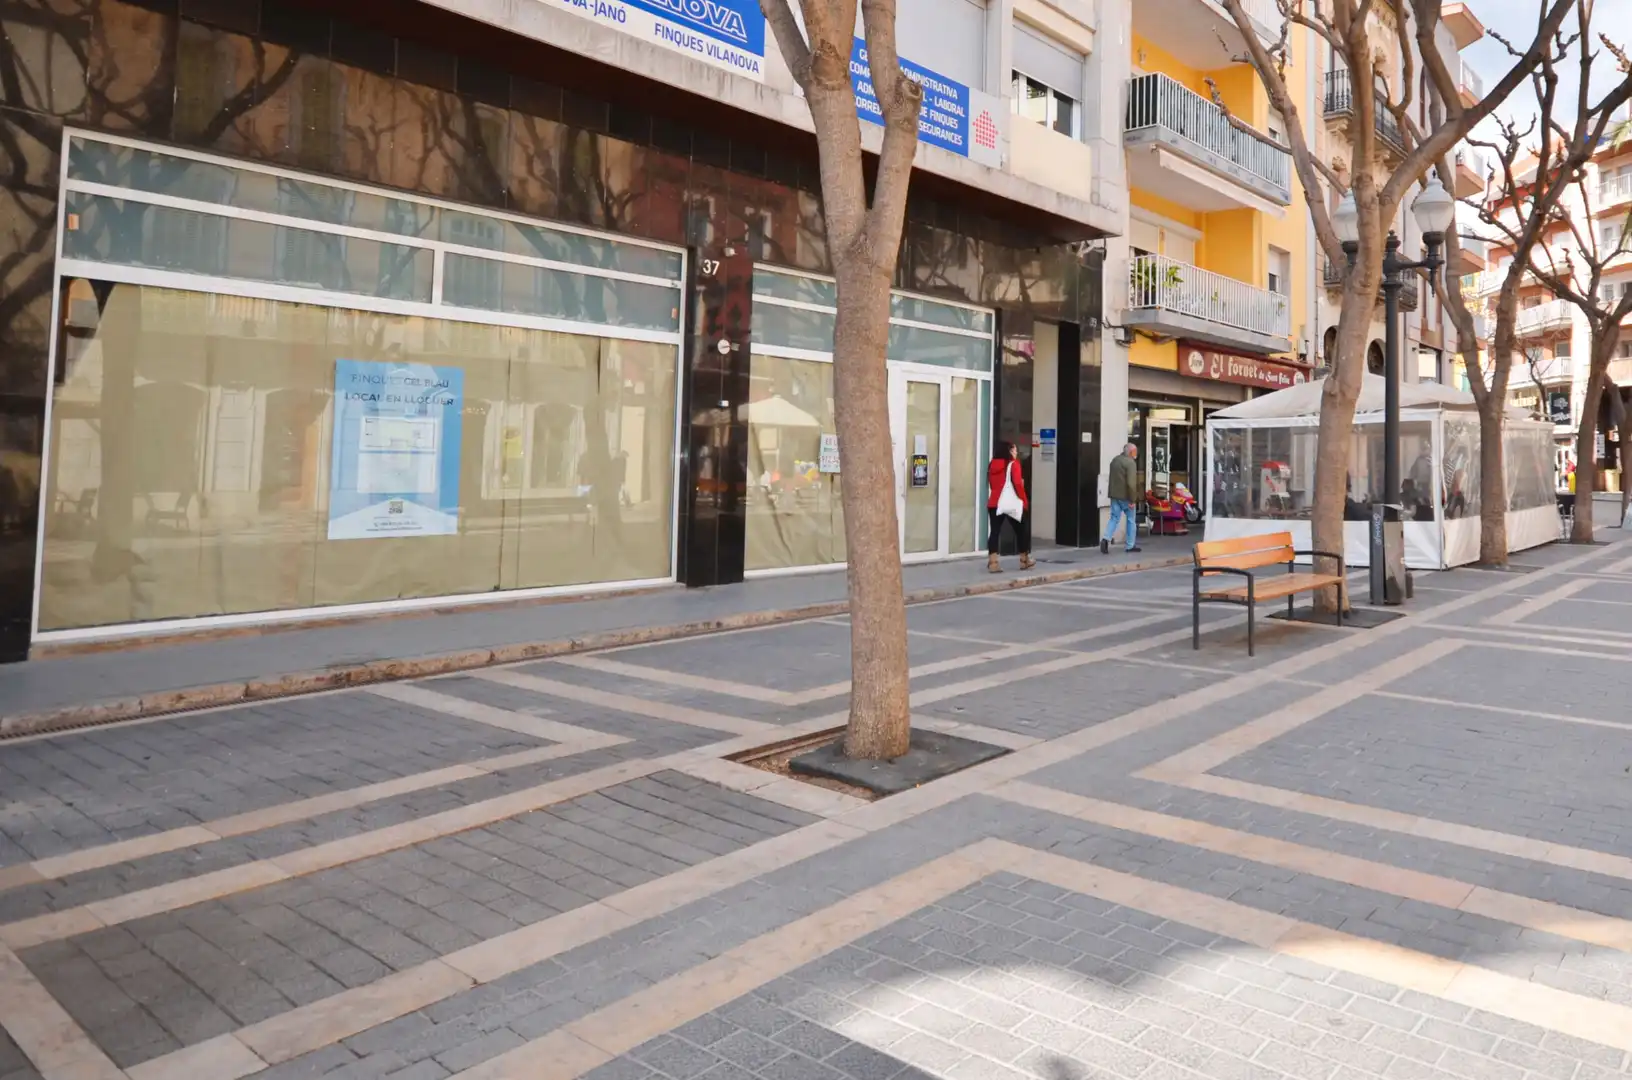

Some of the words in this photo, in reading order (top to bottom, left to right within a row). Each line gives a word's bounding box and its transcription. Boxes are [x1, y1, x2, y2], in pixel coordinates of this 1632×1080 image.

[654, 22, 704, 53] FINQUES
[706, 42, 760, 73] VILANOVA
[934, 96, 966, 118] LABORAL
[929, 108, 959, 129] FINQUES
[917, 120, 963, 146] SEGURANCES
[703, 259, 720, 275] 37
[1211, 353, 1224, 379] El
[1228, 356, 1258, 379] fornet
[344, 392, 381, 403] LOCAL
[385, 394, 402, 403] EN
